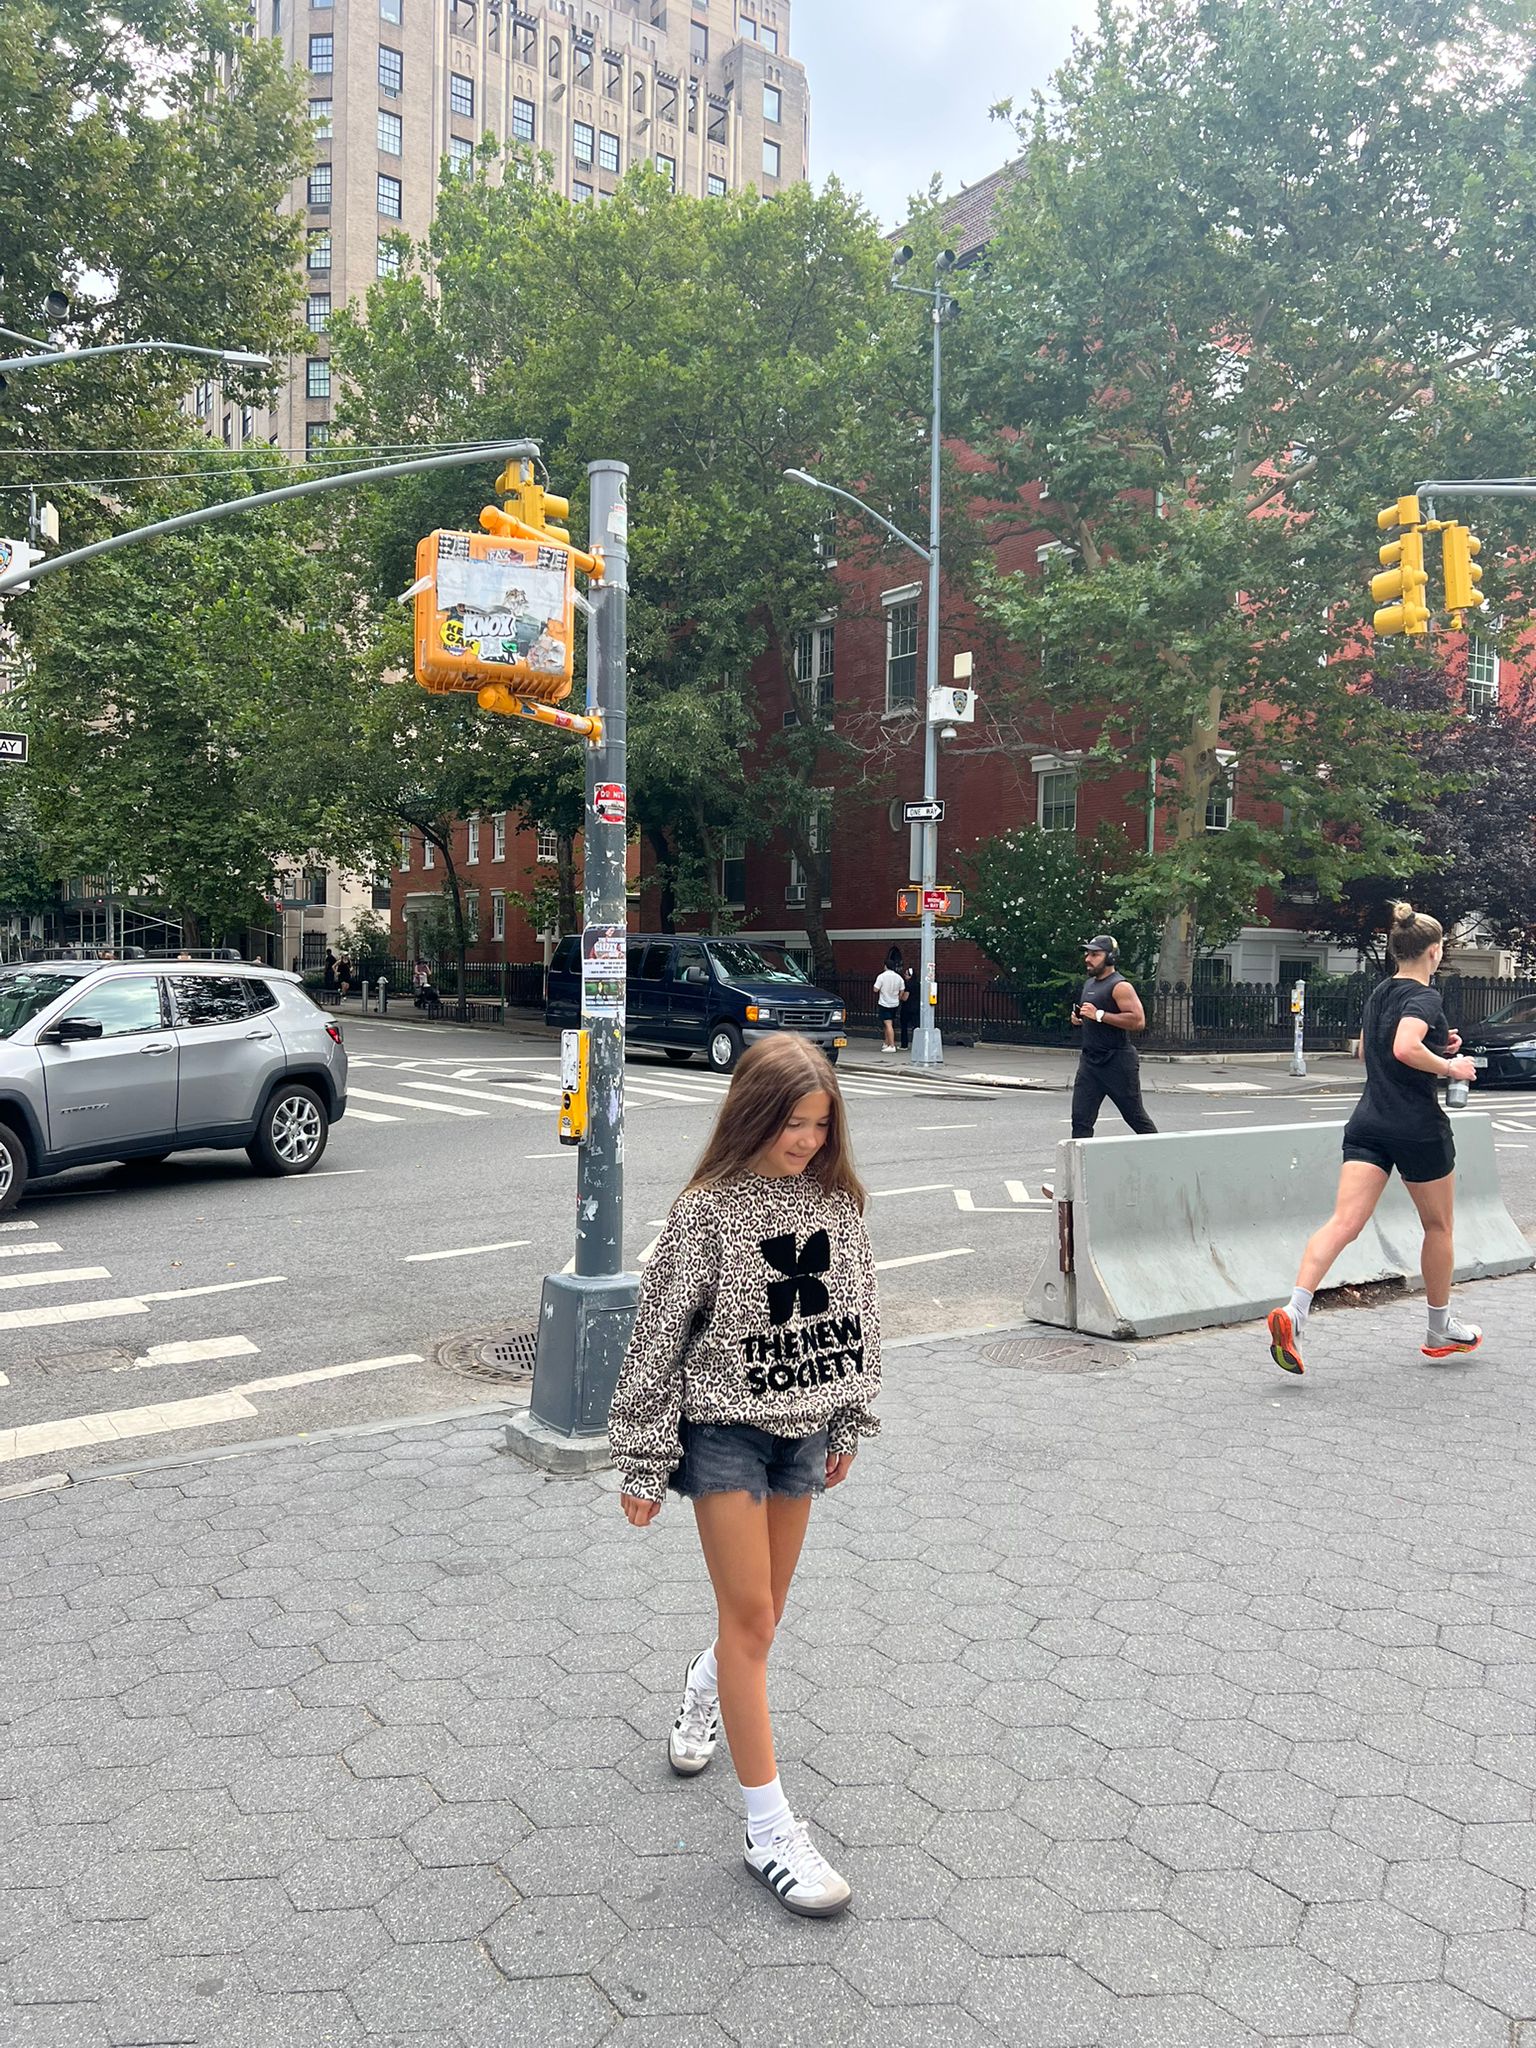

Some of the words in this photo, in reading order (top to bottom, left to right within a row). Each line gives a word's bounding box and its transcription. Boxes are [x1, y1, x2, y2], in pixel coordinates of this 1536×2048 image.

[446, 623, 464, 636] KE
[465, 615, 514, 638] KNOX
[0, 741, 17, 752] AY
[910, 808, 921, 816] ONE
[926, 807, 938, 815] WAY
[740, 1332, 800, 1363] THE
[800, 1314, 862, 1355] NEW
[748, 1345, 864, 1395] SOCIETY
